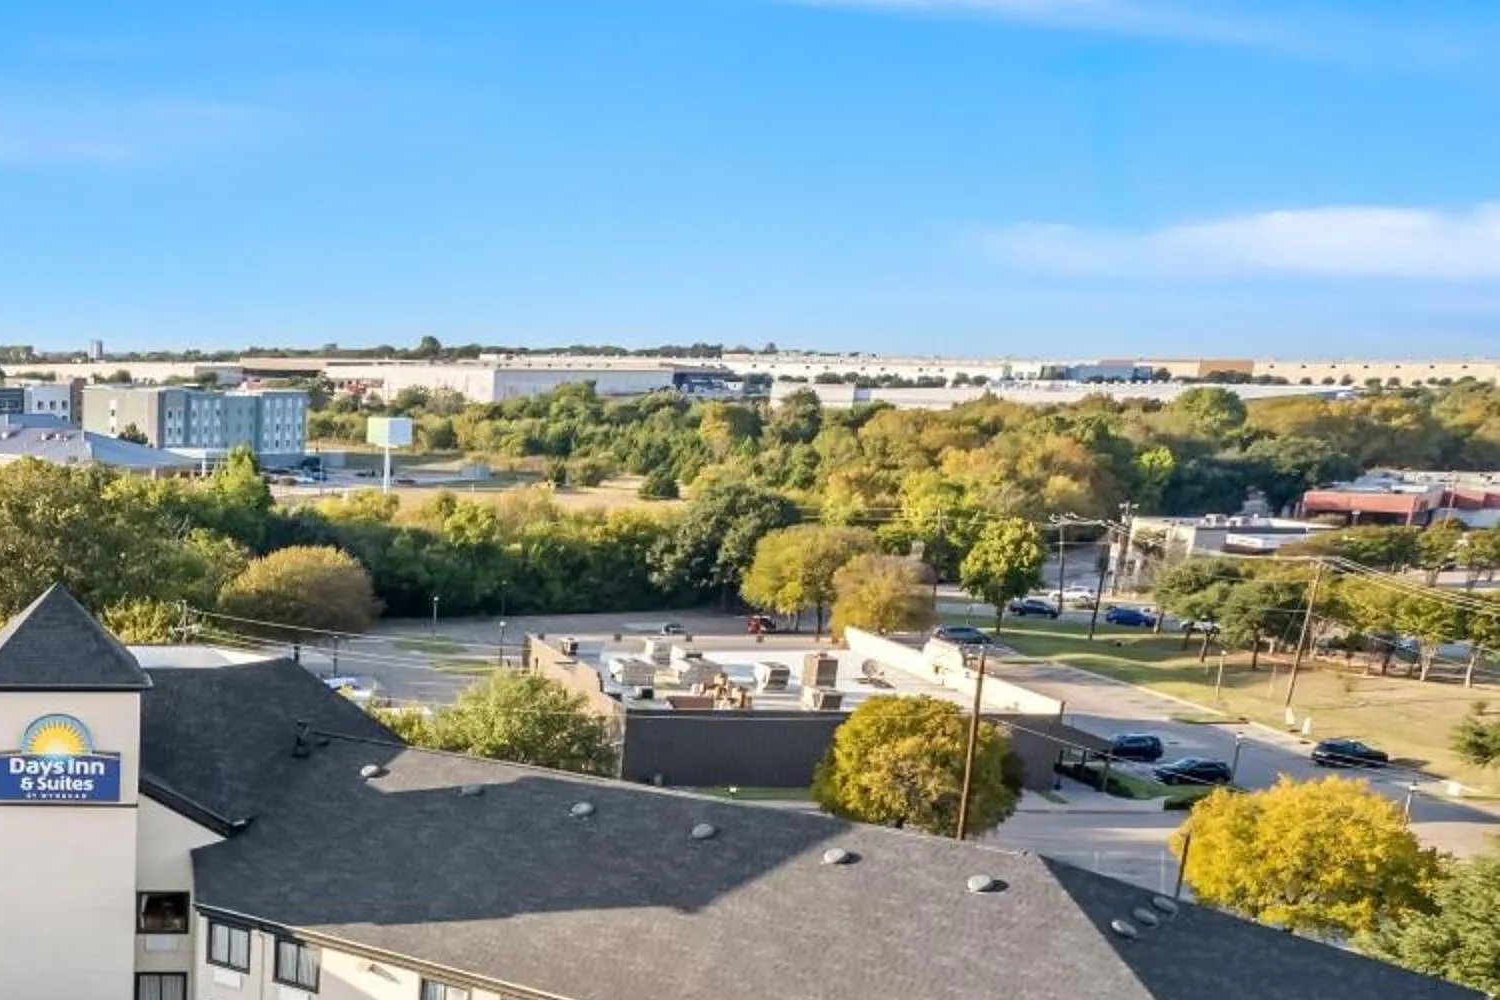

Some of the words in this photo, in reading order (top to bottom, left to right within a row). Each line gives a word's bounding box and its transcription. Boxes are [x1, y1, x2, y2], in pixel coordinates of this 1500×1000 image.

[9, 757, 65, 776] Days
[67, 757, 105, 775] Inn
[20, 777, 34, 791] &
[37, 776, 95, 791] Suites
